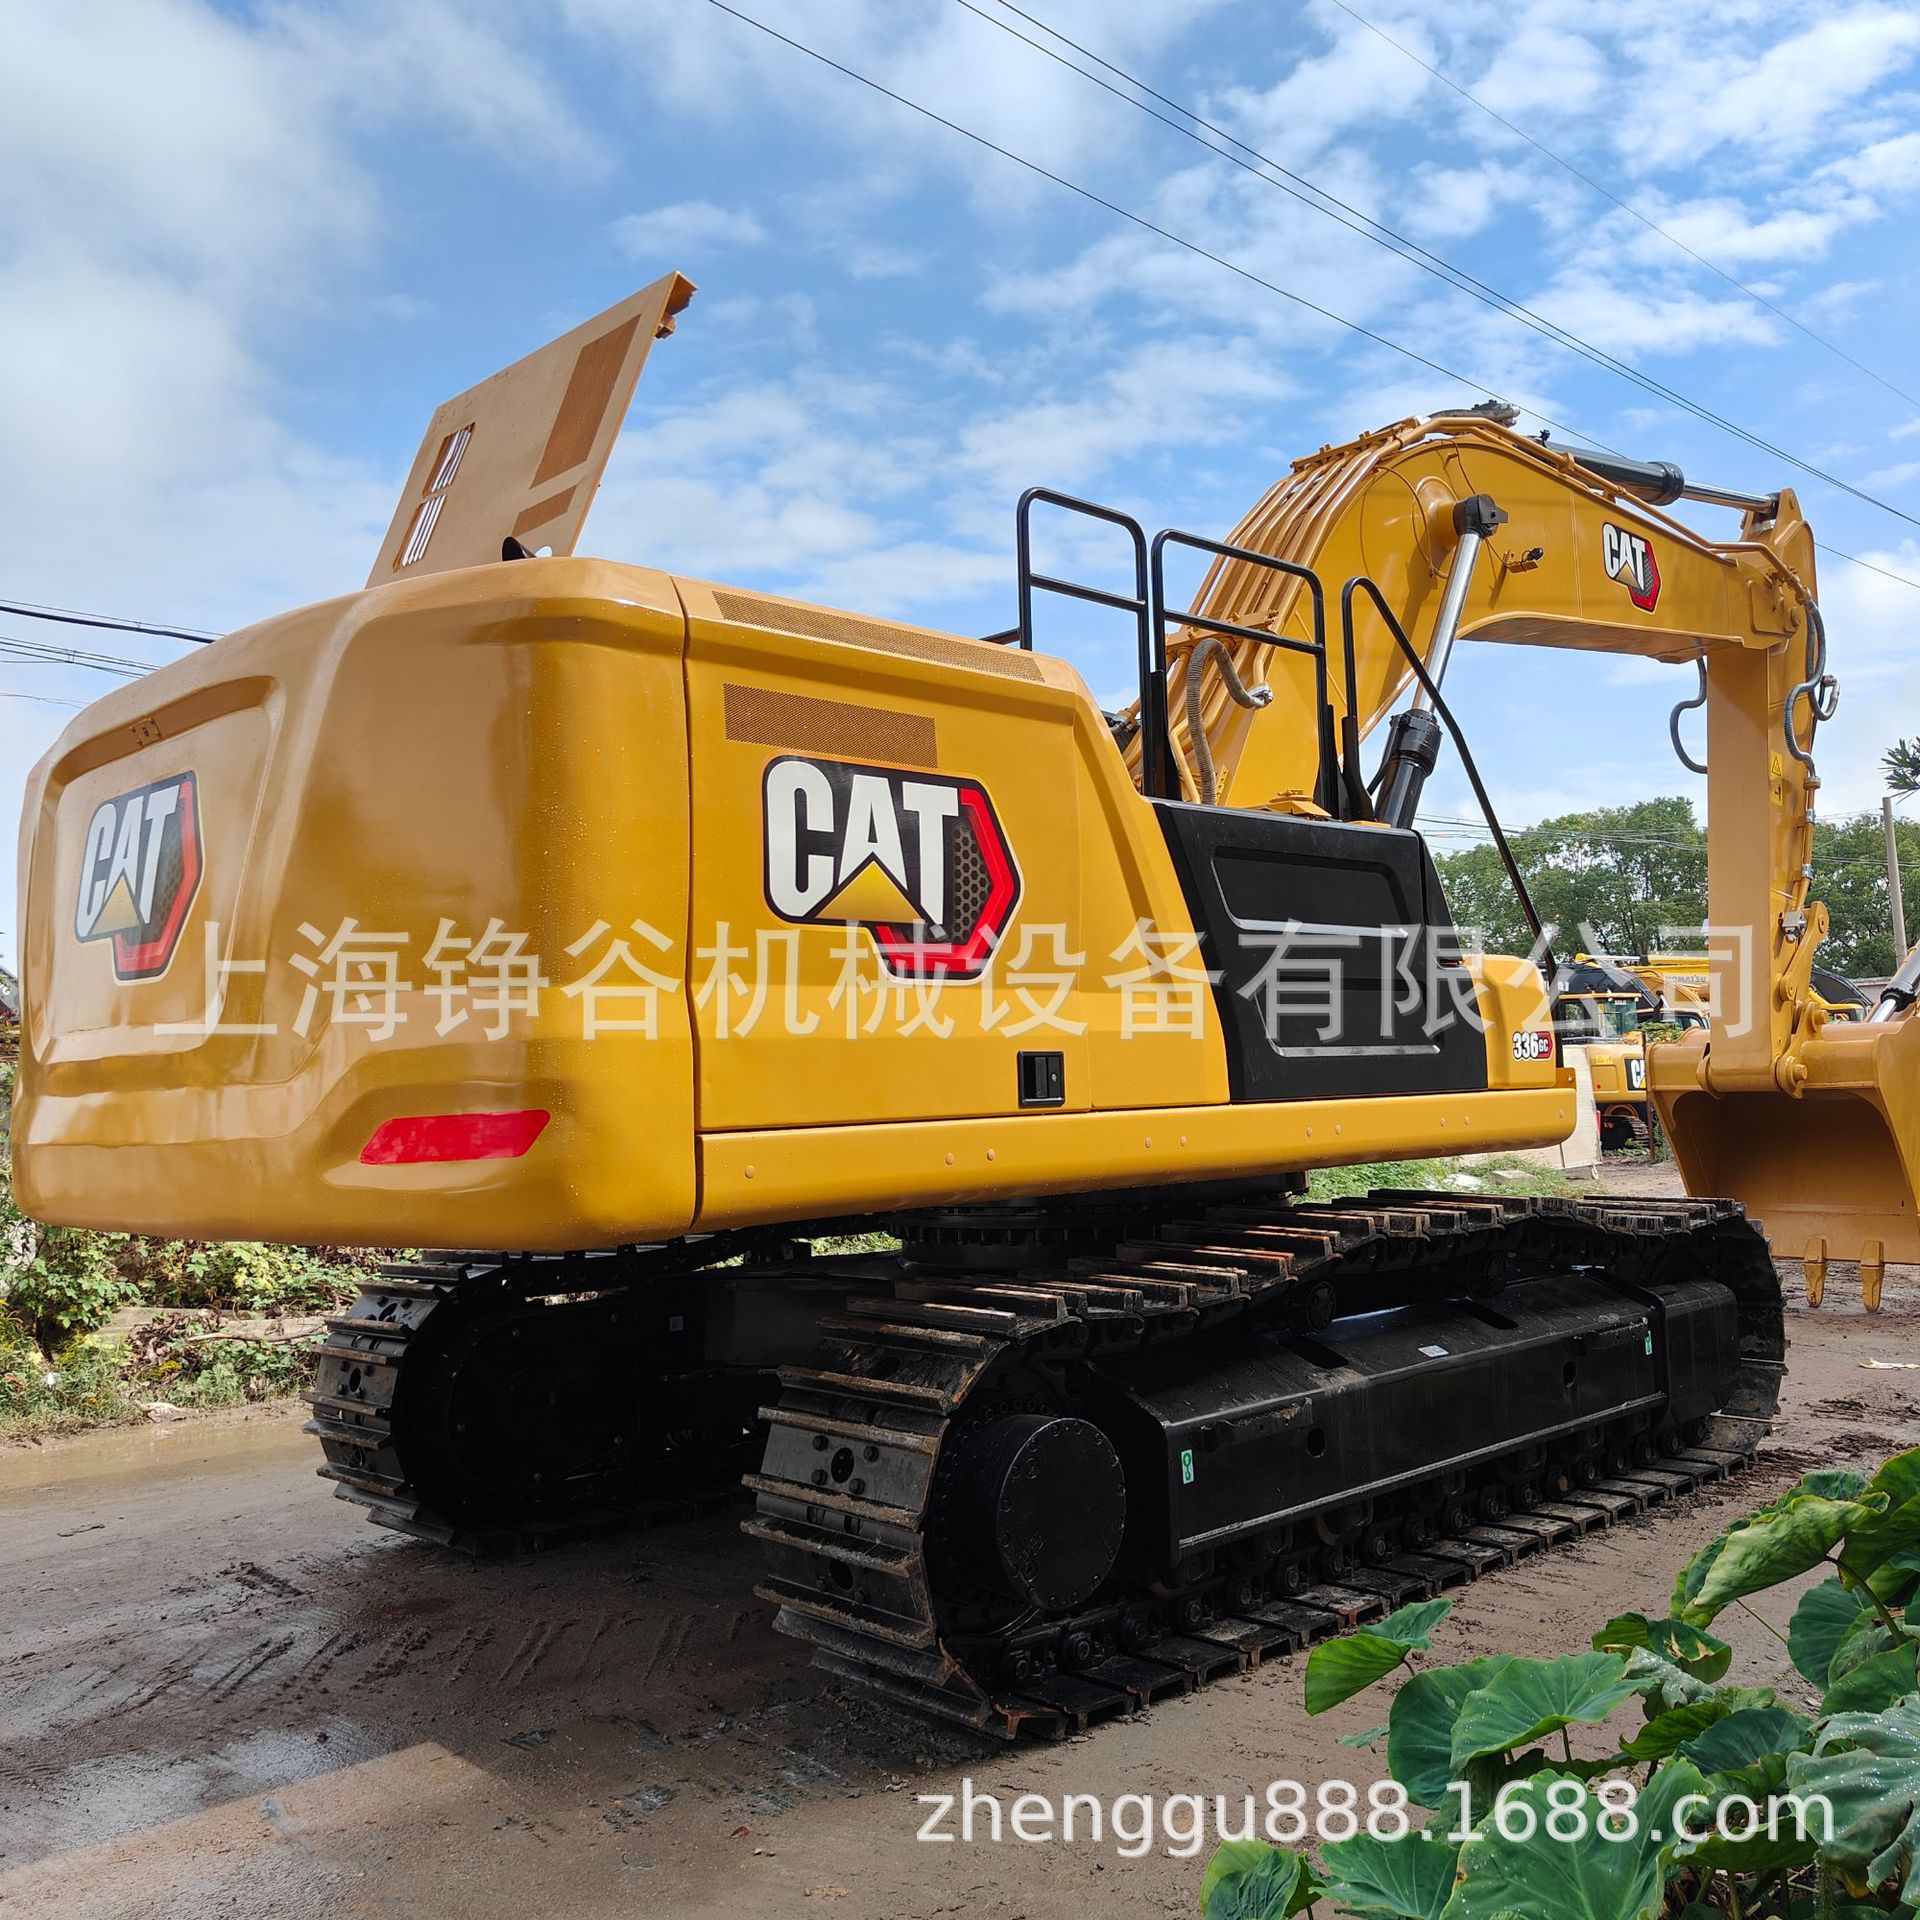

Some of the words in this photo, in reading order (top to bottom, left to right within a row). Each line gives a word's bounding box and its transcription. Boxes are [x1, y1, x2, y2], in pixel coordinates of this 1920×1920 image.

[1603, 523, 1646, 591] CAT
[79, 784, 181, 938] CAT
[767, 760, 959, 925] CAT
[1513, 1032, 1538, 1059] 336
[1538, 1039, 1549, 1053] GC
